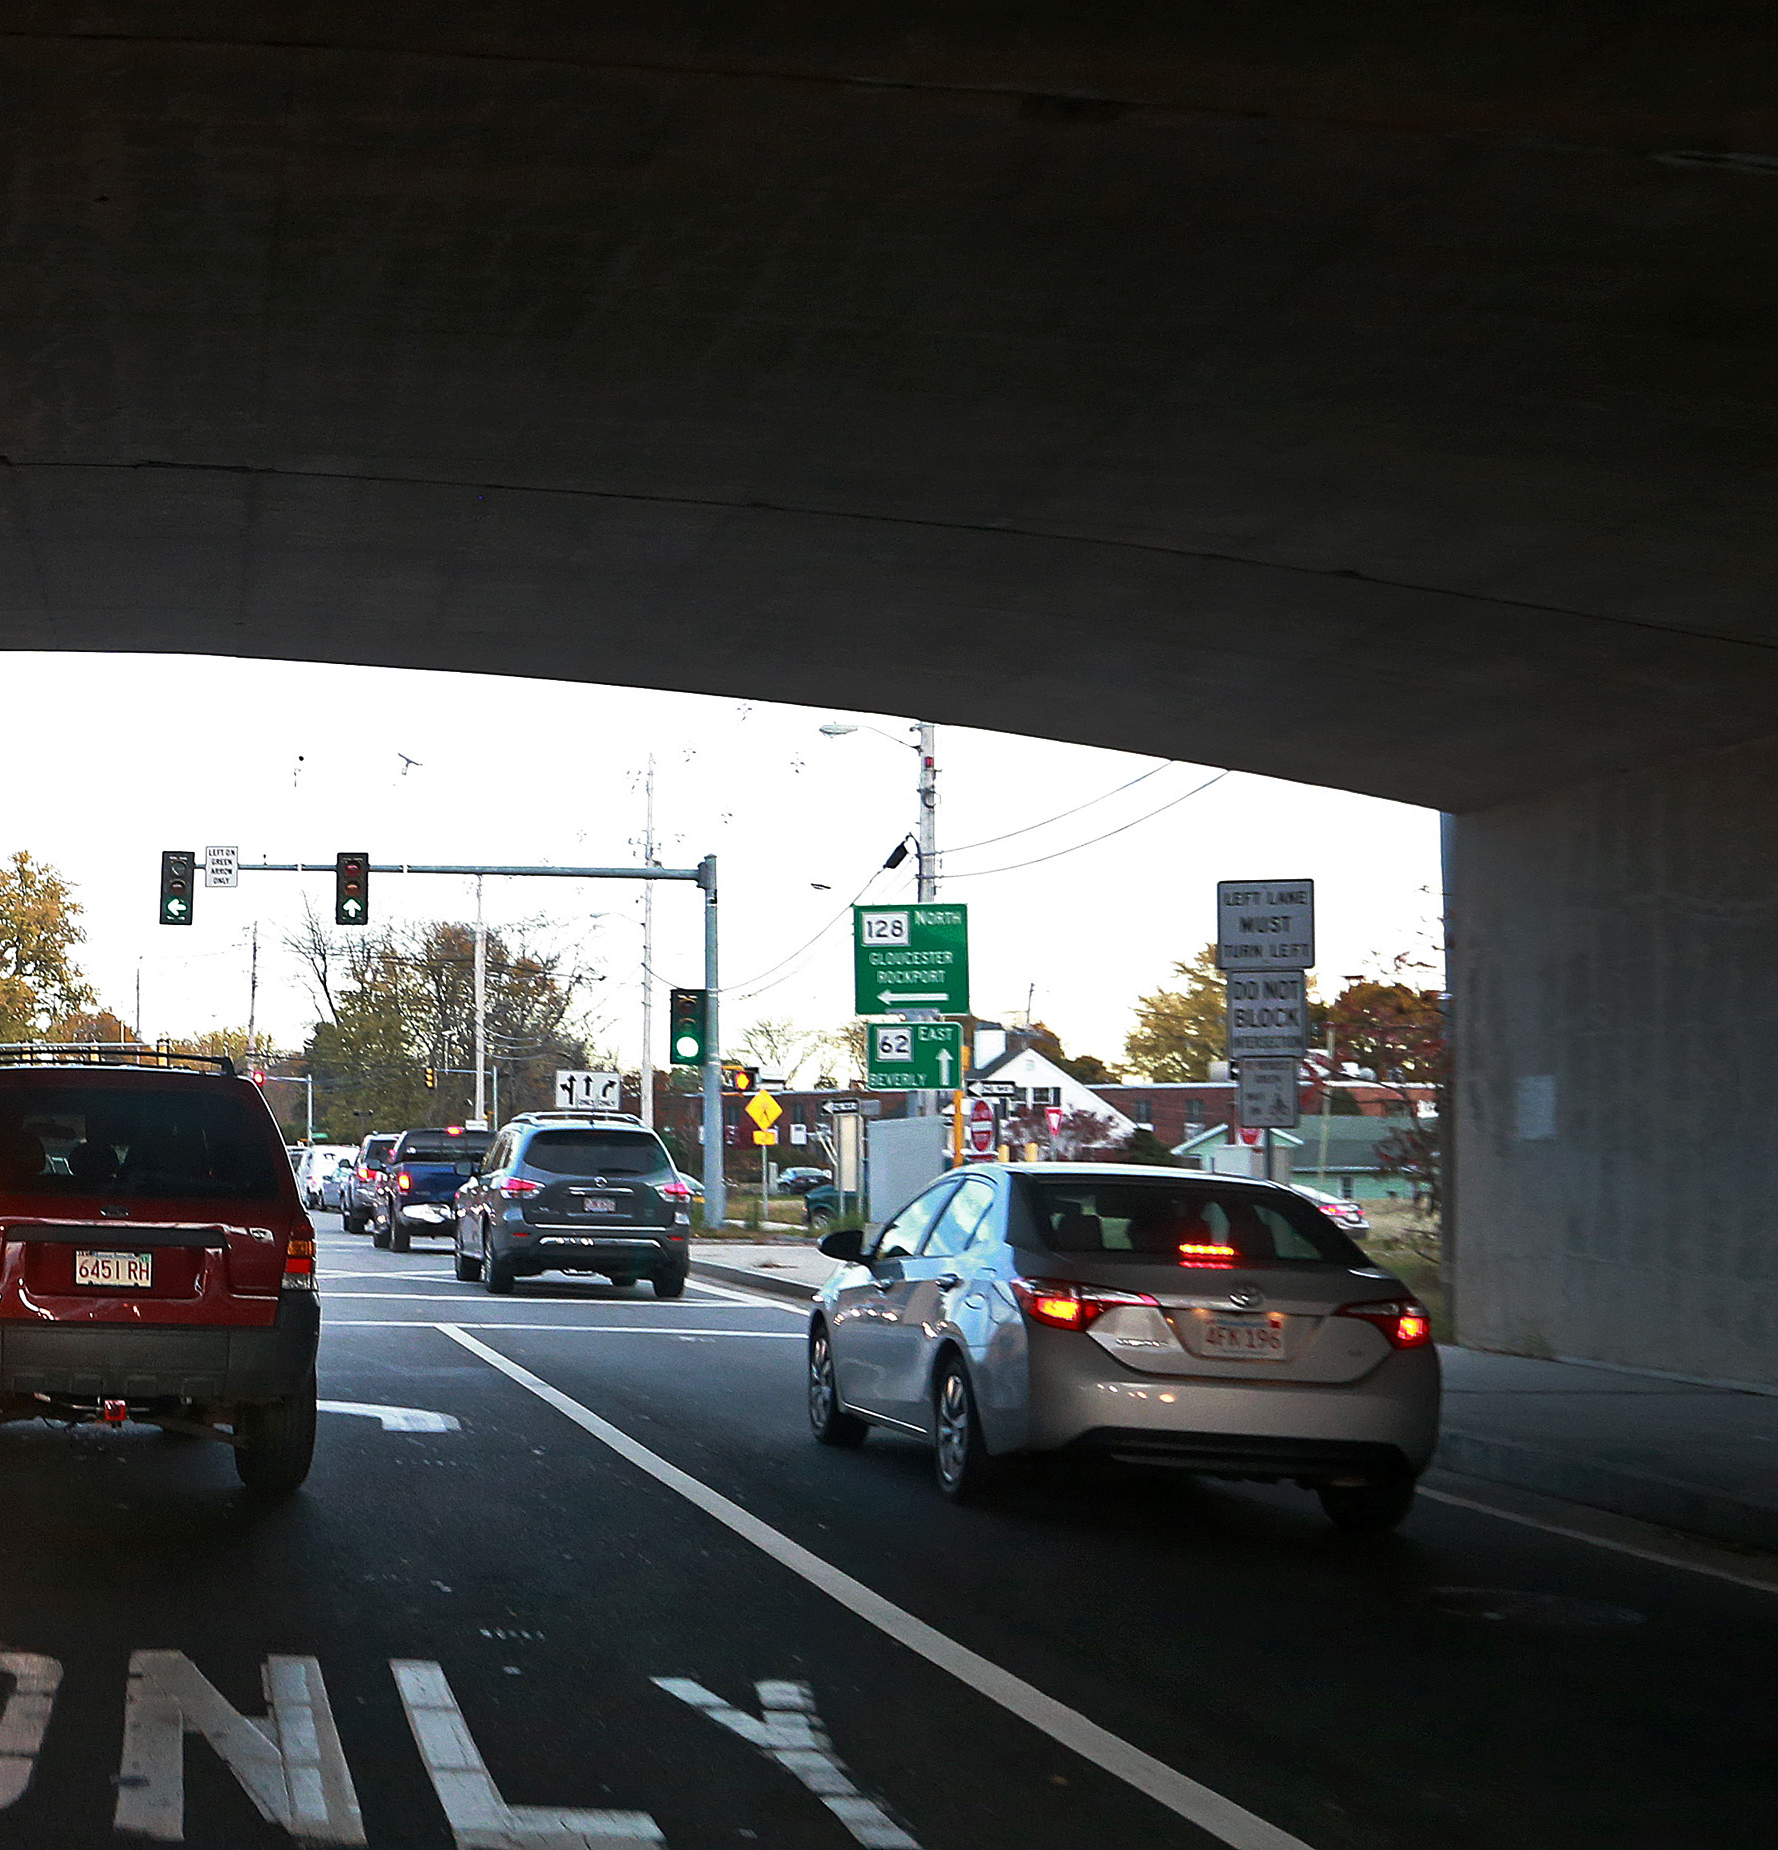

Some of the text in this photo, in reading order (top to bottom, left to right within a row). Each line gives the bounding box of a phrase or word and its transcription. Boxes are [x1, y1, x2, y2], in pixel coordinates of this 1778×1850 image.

[1223, 890, 1309, 906] LEFT LANE
[914, 909, 963, 926] NORTH
[1239, 915, 1291, 933] MUST
[866, 919, 904, 939] 128
[868, 951, 954, 966] GLOUCESTER
[1223, 943, 1310, 958] TURN LEFT
[876, 970, 947, 984] ROCKPORT
[1234, 980, 1299, 1000] DO NOT
[1234, 1008, 1300, 1028] BLOCK
[917, 1026, 953, 1041] EAST
[880, 1035, 909, 1054] 62
[868, 1073, 927, 1087] BEVERLY
[79, 1259, 149, 1281] 6451 RH
